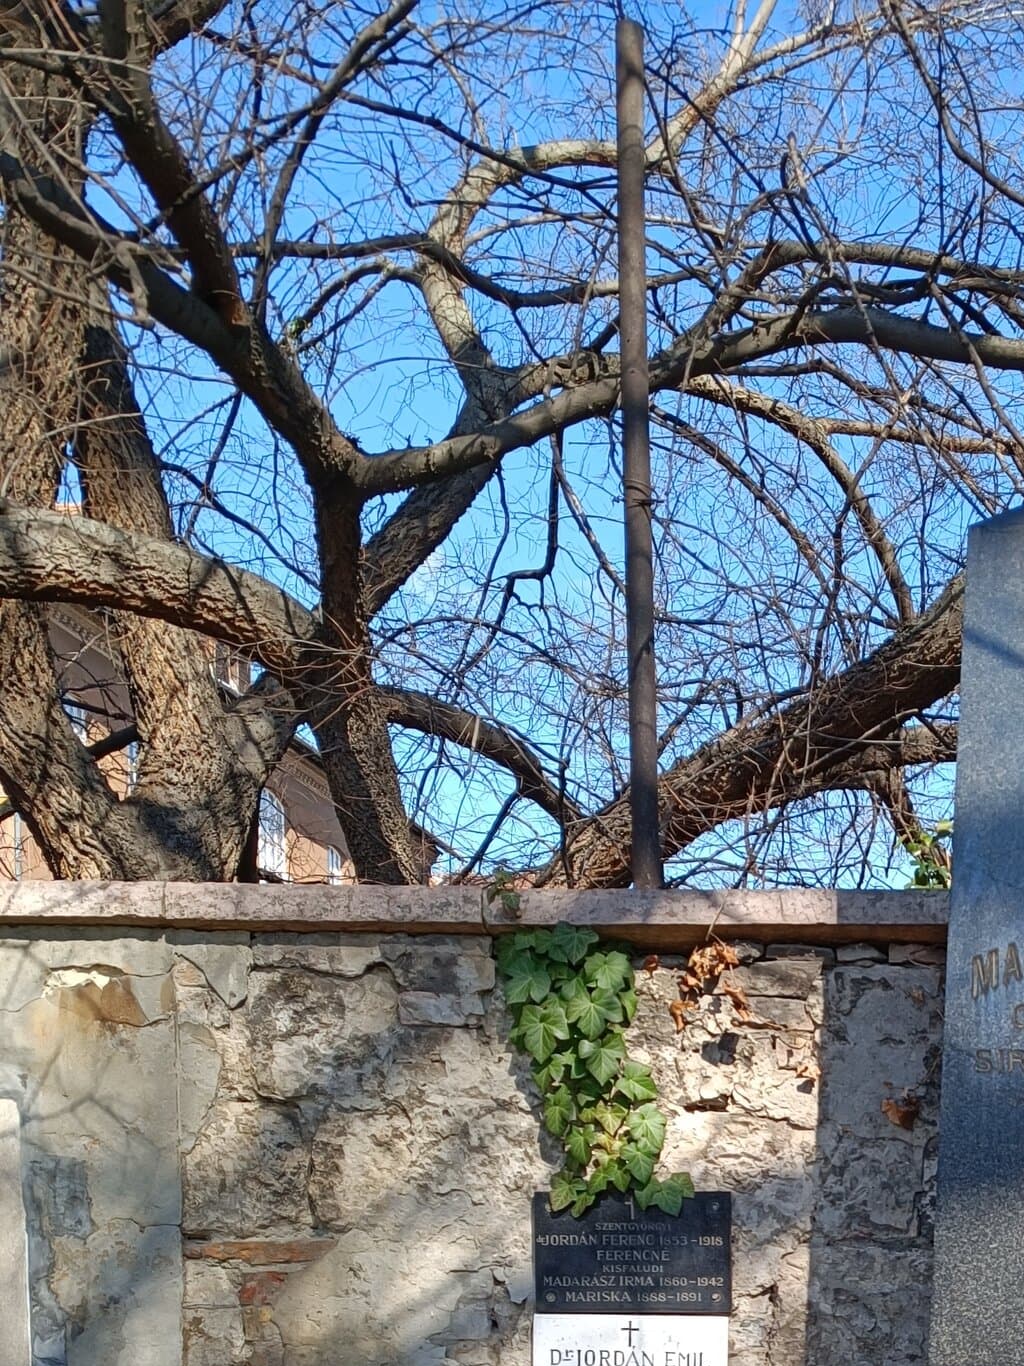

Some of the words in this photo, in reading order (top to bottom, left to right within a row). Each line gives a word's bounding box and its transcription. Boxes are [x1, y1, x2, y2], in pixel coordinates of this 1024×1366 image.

[543, 1231, 597, 1246] JORDÁN
[603, 1234, 655, 1246] FERENC
[596, 1247, 671, 1261] FERENCNÉ
[602, 1264, 664, 1273] KISFALUDI
[543, 1272, 616, 1287] MADARÁSZ
[619, 1275, 655, 1287] IRMA
[565, 1290, 632, 1303] MARISKA
